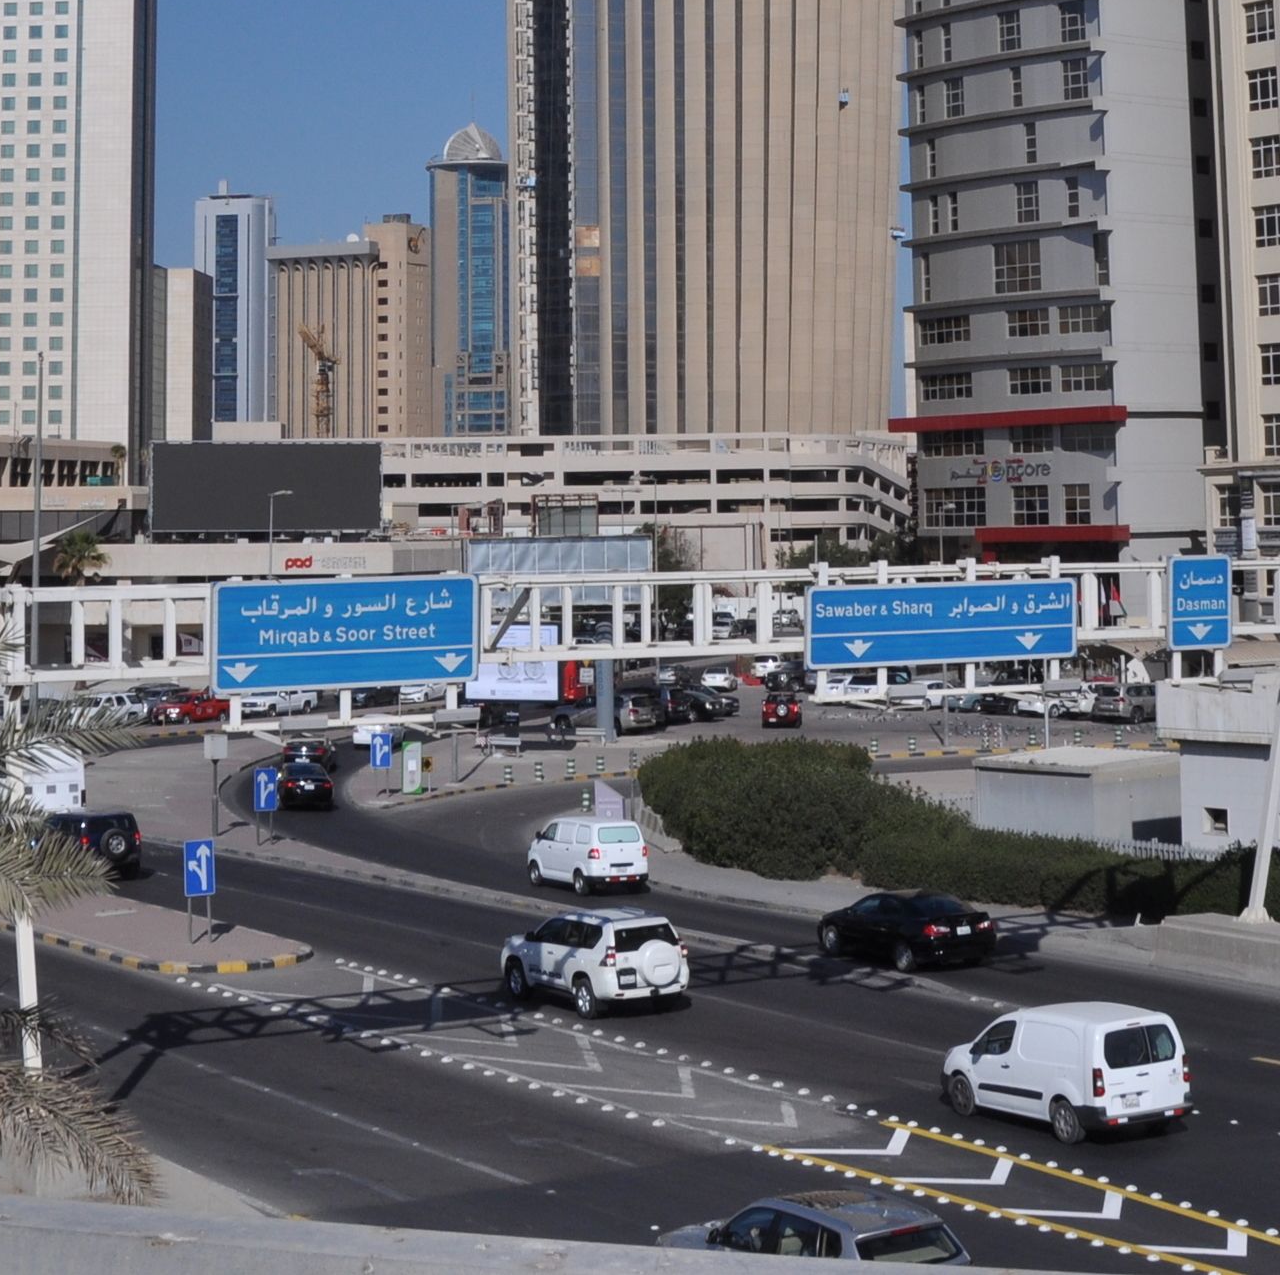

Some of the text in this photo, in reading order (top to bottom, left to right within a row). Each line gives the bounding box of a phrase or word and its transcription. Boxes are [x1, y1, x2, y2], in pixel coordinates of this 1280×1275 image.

[285, 555, 313, 571] pad
[1179, 571, 1224, 590] دسمان
[240, 588, 453, 623] شارع السور و المرقاب
[815, 600, 933, 618] Sawaber & Sharq
[948, 592, 1070, 618] الشرق و الصوابر
[1177, 598, 1225, 611] Dasman
[259, 623, 436, 647] Mirqab & Soor Street
